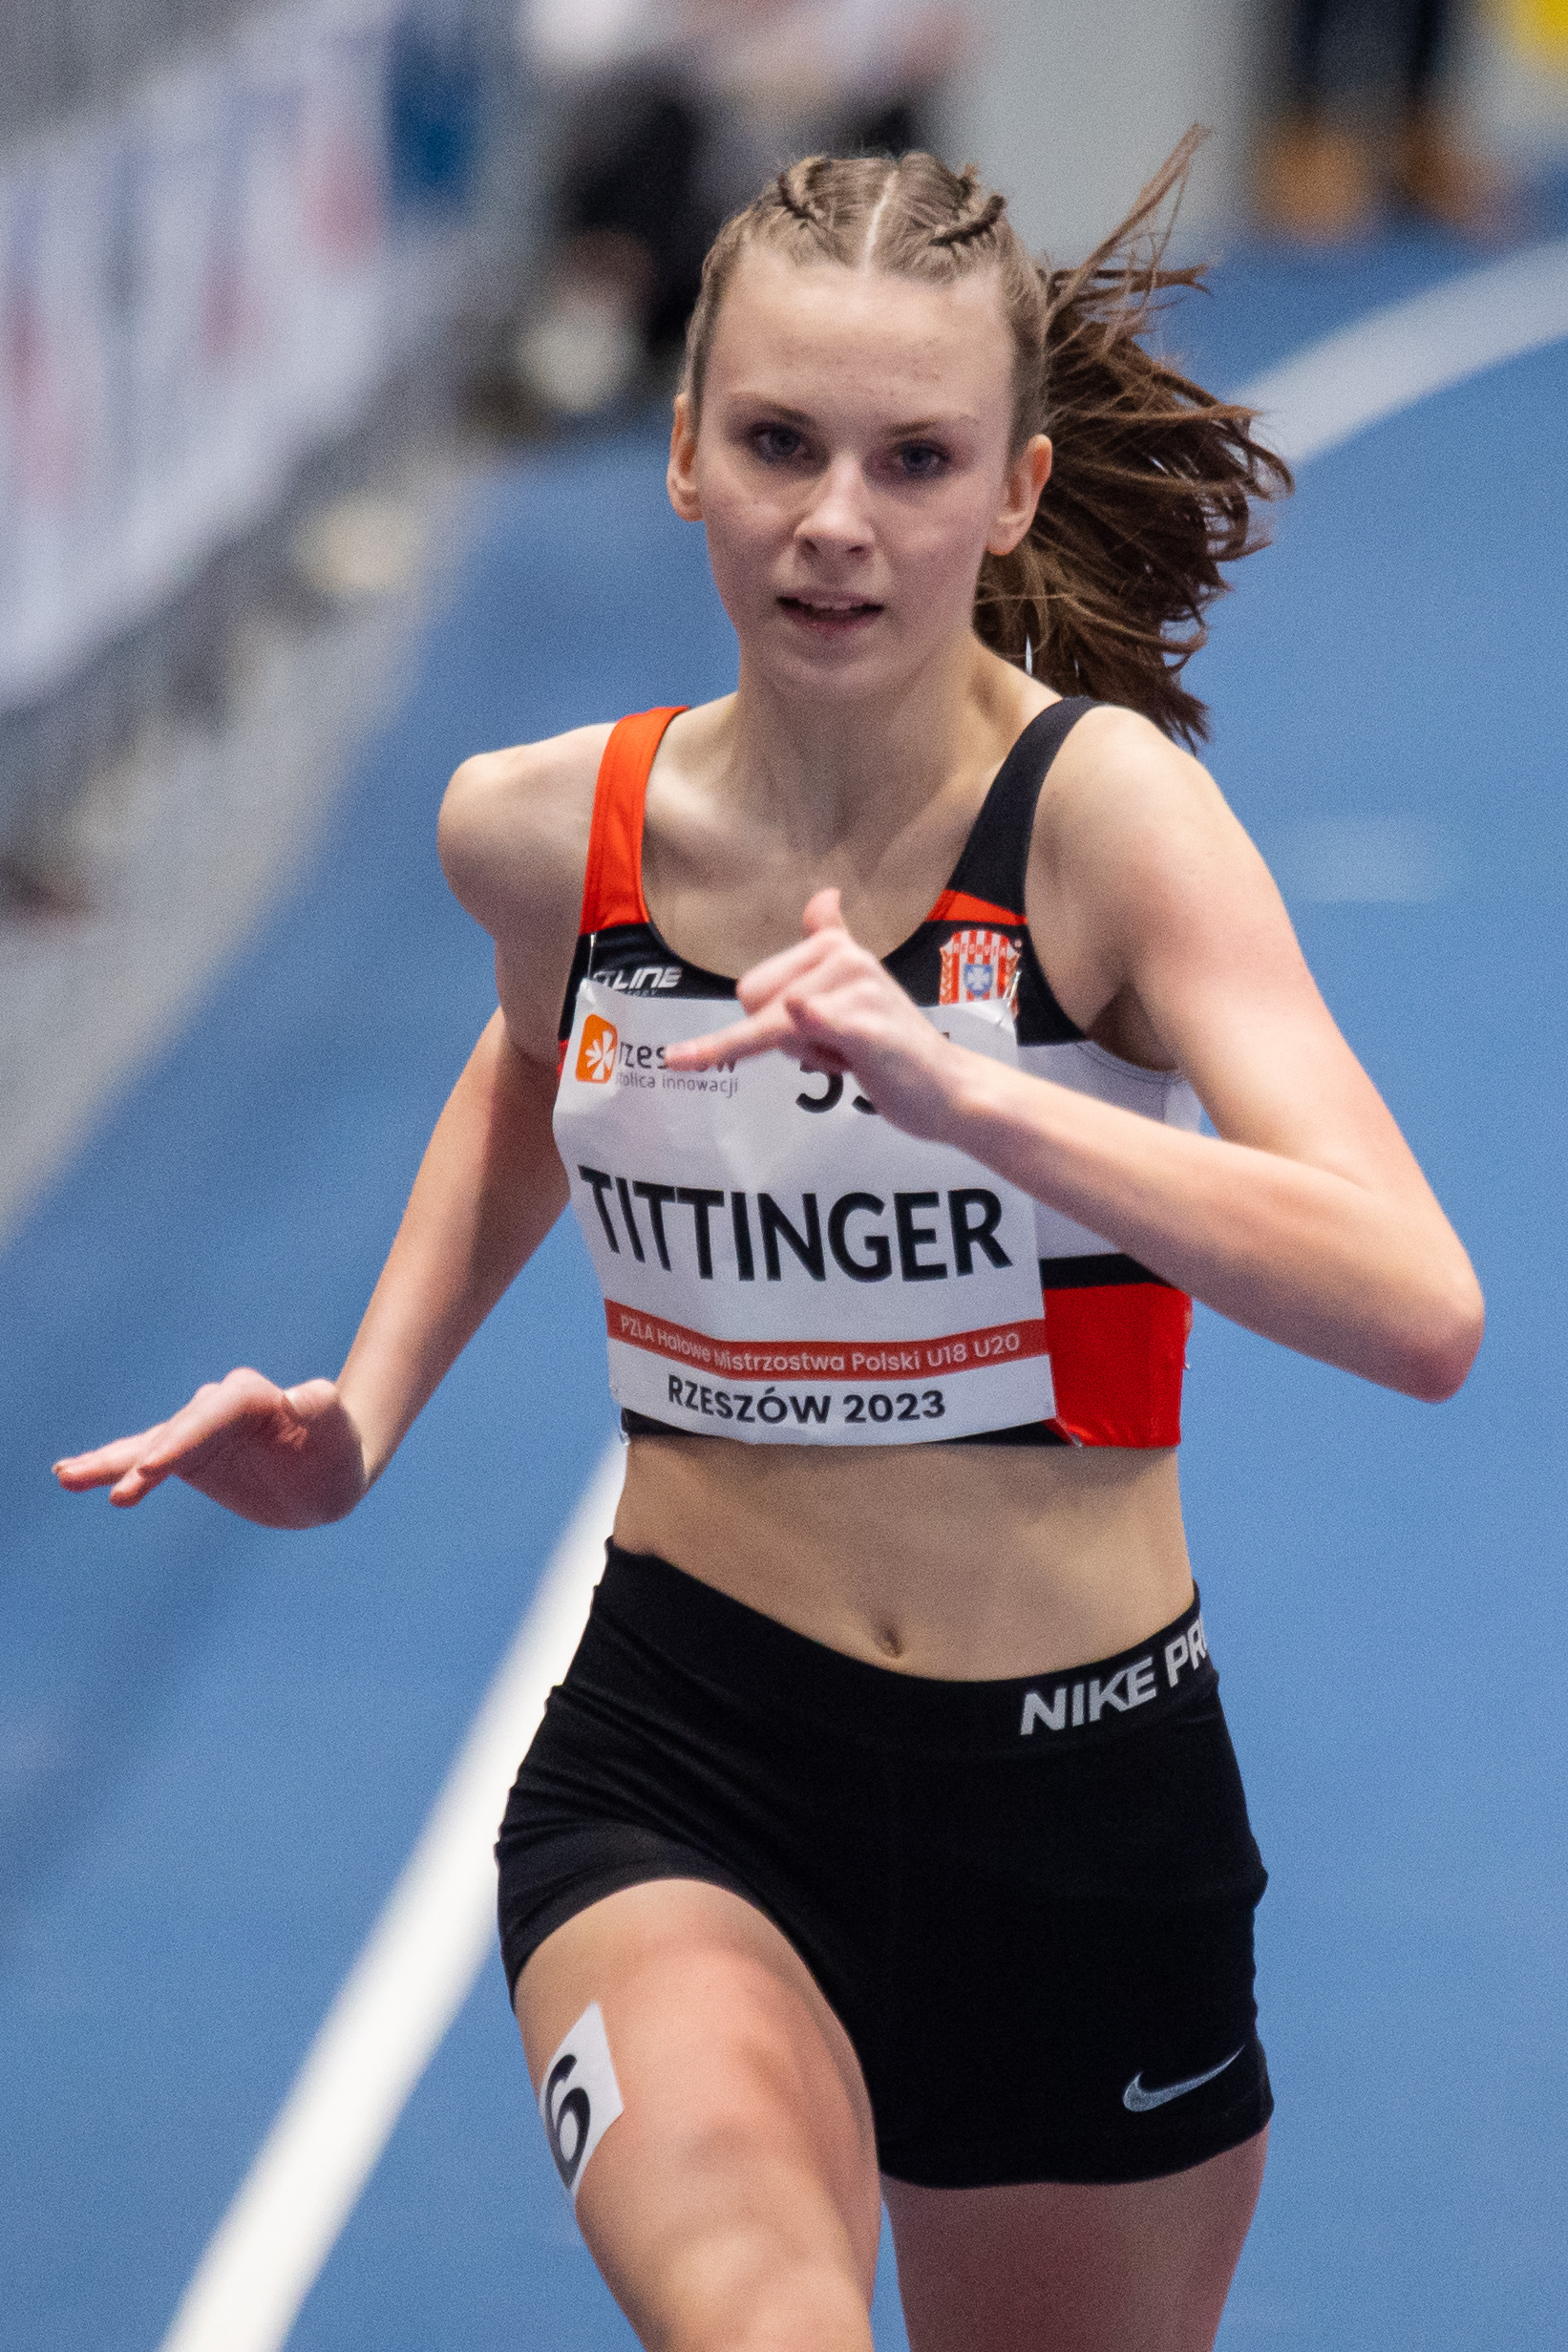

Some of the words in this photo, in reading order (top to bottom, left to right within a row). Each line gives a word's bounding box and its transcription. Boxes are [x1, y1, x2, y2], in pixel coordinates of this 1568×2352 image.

[662, 1074, 739, 1099] innowacji
[578, 1165, 1013, 1282] TITTINGER
[621, 1314, 654, 1344] PZLA
[657, 1328, 711, 1363] Halowe
[714, 1347, 845, 1372] Mistrzostwa
[851, 1350, 921, 1372] Polski
[926, 1343, 967, 1367] U18
[974, 1332, 1020, 1359] U20
[668, 1373, 832, 1425] RZESZÓW
[842, 1389, 946, 1424] 2023
[1019, 1655, 1157, 1736] NIKE
[544, 2053, 591, 2191] 6
